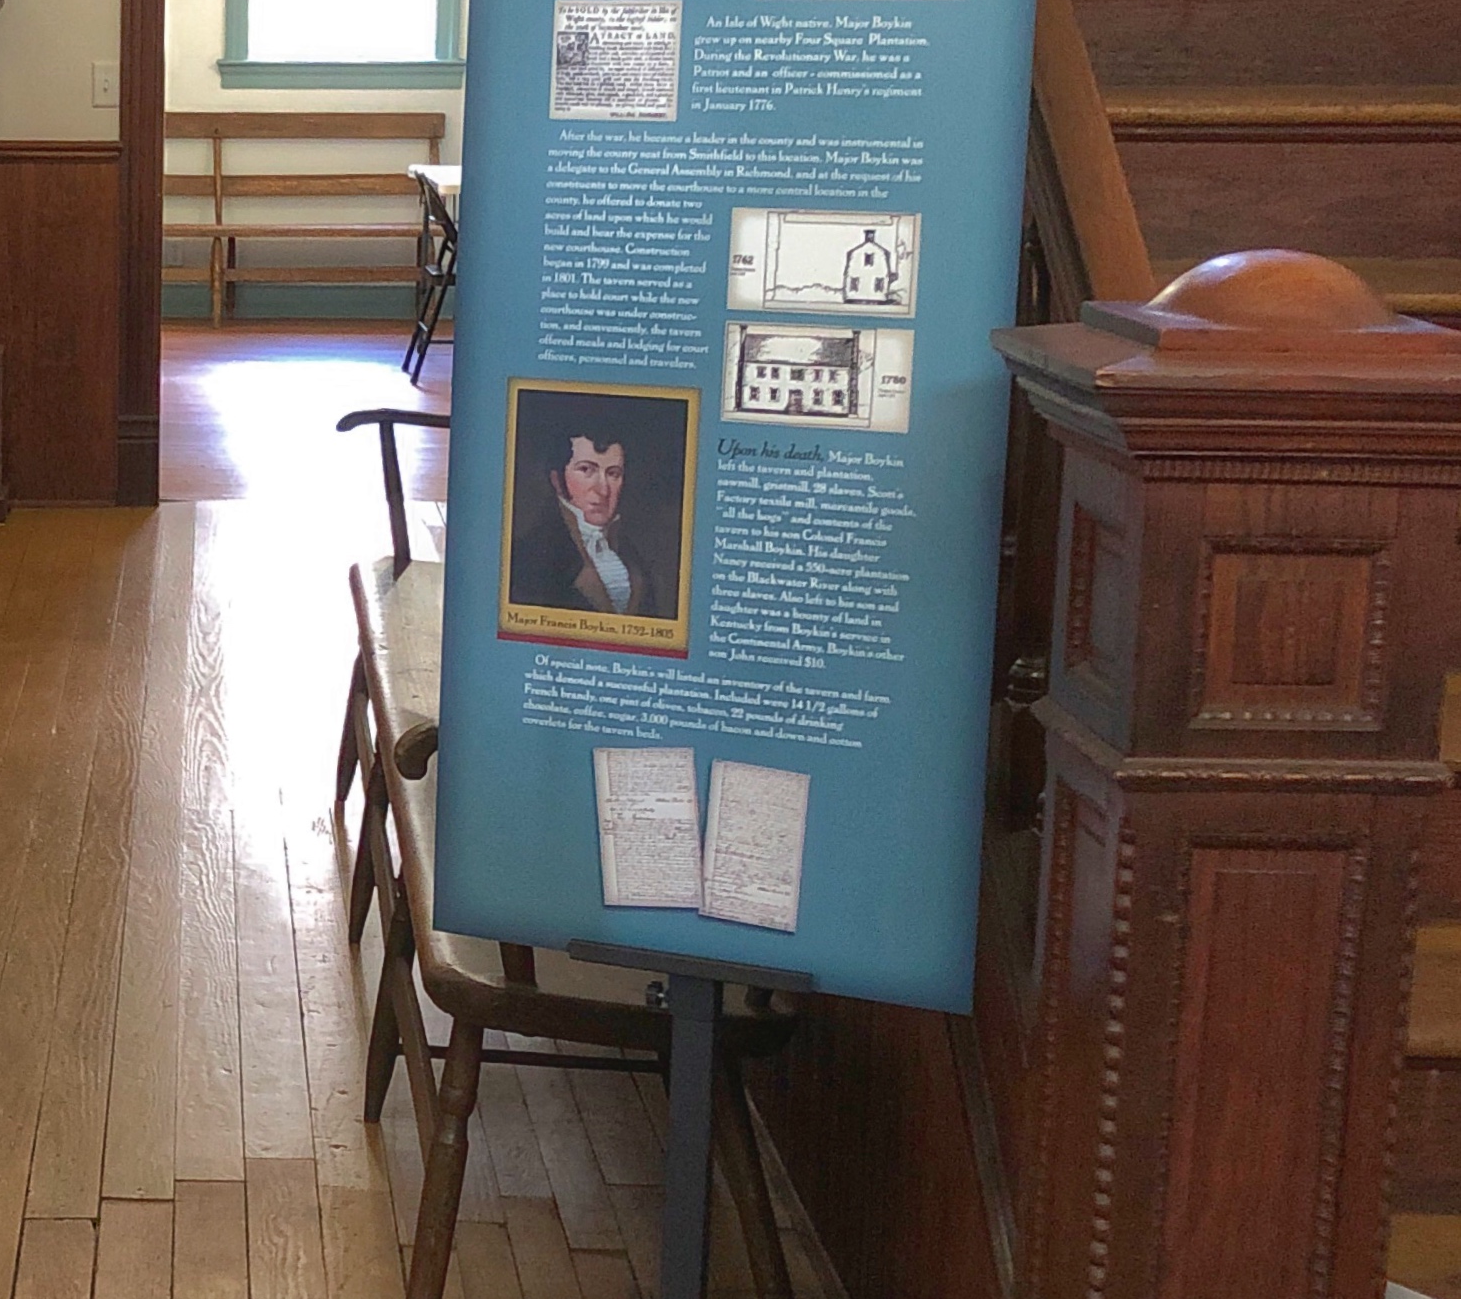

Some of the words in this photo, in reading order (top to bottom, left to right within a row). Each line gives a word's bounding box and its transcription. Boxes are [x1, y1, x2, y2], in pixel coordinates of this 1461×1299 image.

[706, 15, 722, 27] An
[724, 15, 745, 27] Isle
[745, 15, 758, 27] of
[759, 16, 793, 30] Wight
[835, 16, 869, 31] Major
[871, 16, 912, 31] Boykin
[694, 35, 720, 46] grew
[722, 35, 737, 46] up
[738, 35, 752, 43] on
[754, 32, 793, 47] nearby
[794, 32, 822, 44] Four
[822, 32, 863, 47] Square
[693, 48, 732, 63] During
[734, 48, 751, 60] the
[753, 49, 831, 64] Revolutionary
[861, 50, 876, 62] he
[878, 54, 901, 62] was
[693, 64, 730, 76] Patriot
[731, 65, 753, 77] and
[771, 65, 808, 78] officer
[691, 81, 713, 93] first
[715, 81, 769, 94] lieutenant
[771, 83, 782, 94] in
[784, 82, 823, 95] Patrick
[825, 83, 870, 99] Henry's
[871, 85, 922, 100] regiment
[690, 98, 701, 109] in
[703, 98, 746, 113] January
[718, 438, 757, 459] Upon
[761, 441, 779, 458] his
[507, 611, 538, 626] Major
[540, 615, 577, 629] Francis
